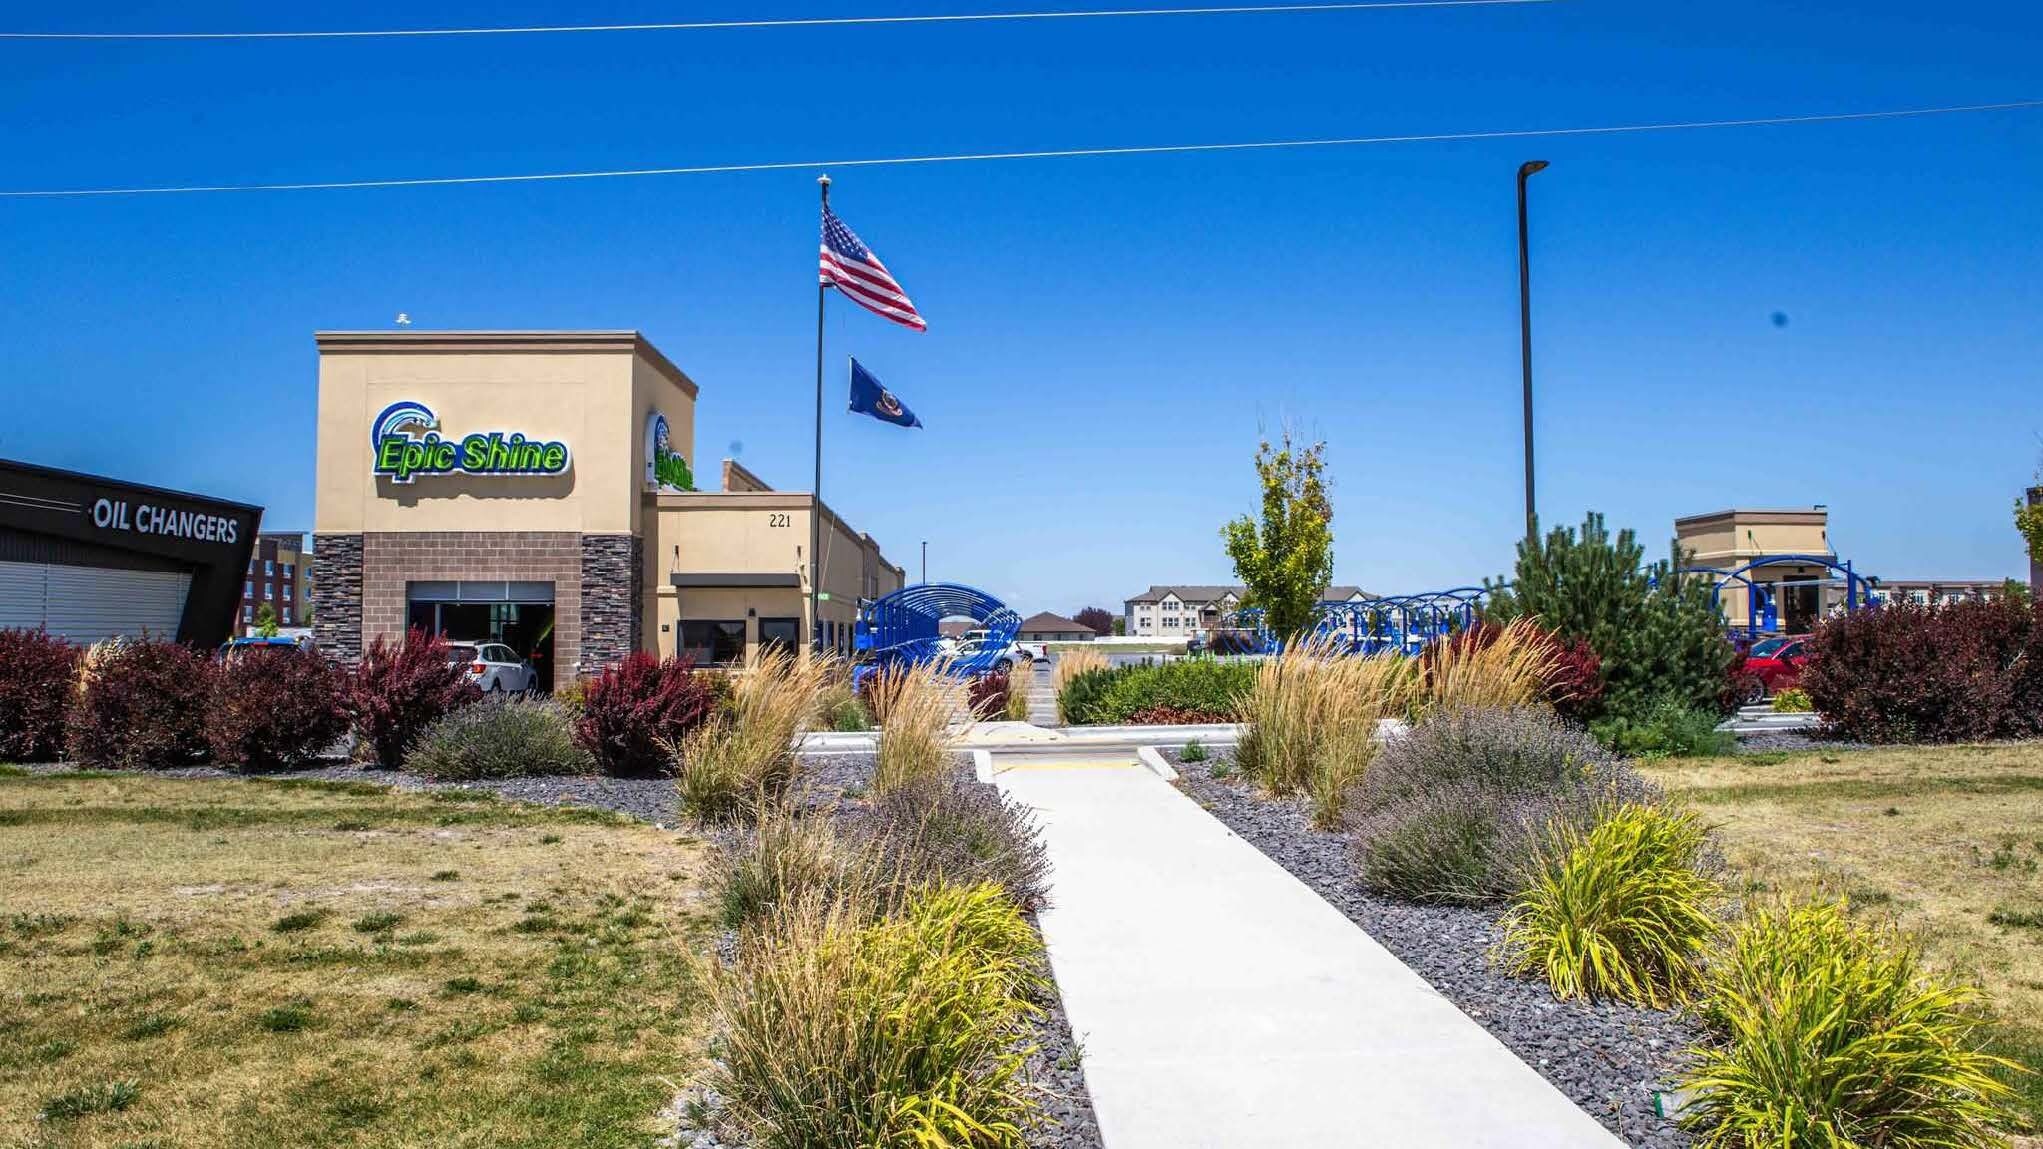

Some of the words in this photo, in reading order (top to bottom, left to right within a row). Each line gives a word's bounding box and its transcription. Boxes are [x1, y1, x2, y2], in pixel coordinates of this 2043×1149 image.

[377, 434, 456, 479] Epic
[462, 433, 565, 470] Shine
[93, 498, 131, 530] OIL
[135, 504, 238, 544] CHANGERS
[769, 513, 791, 528] 221
